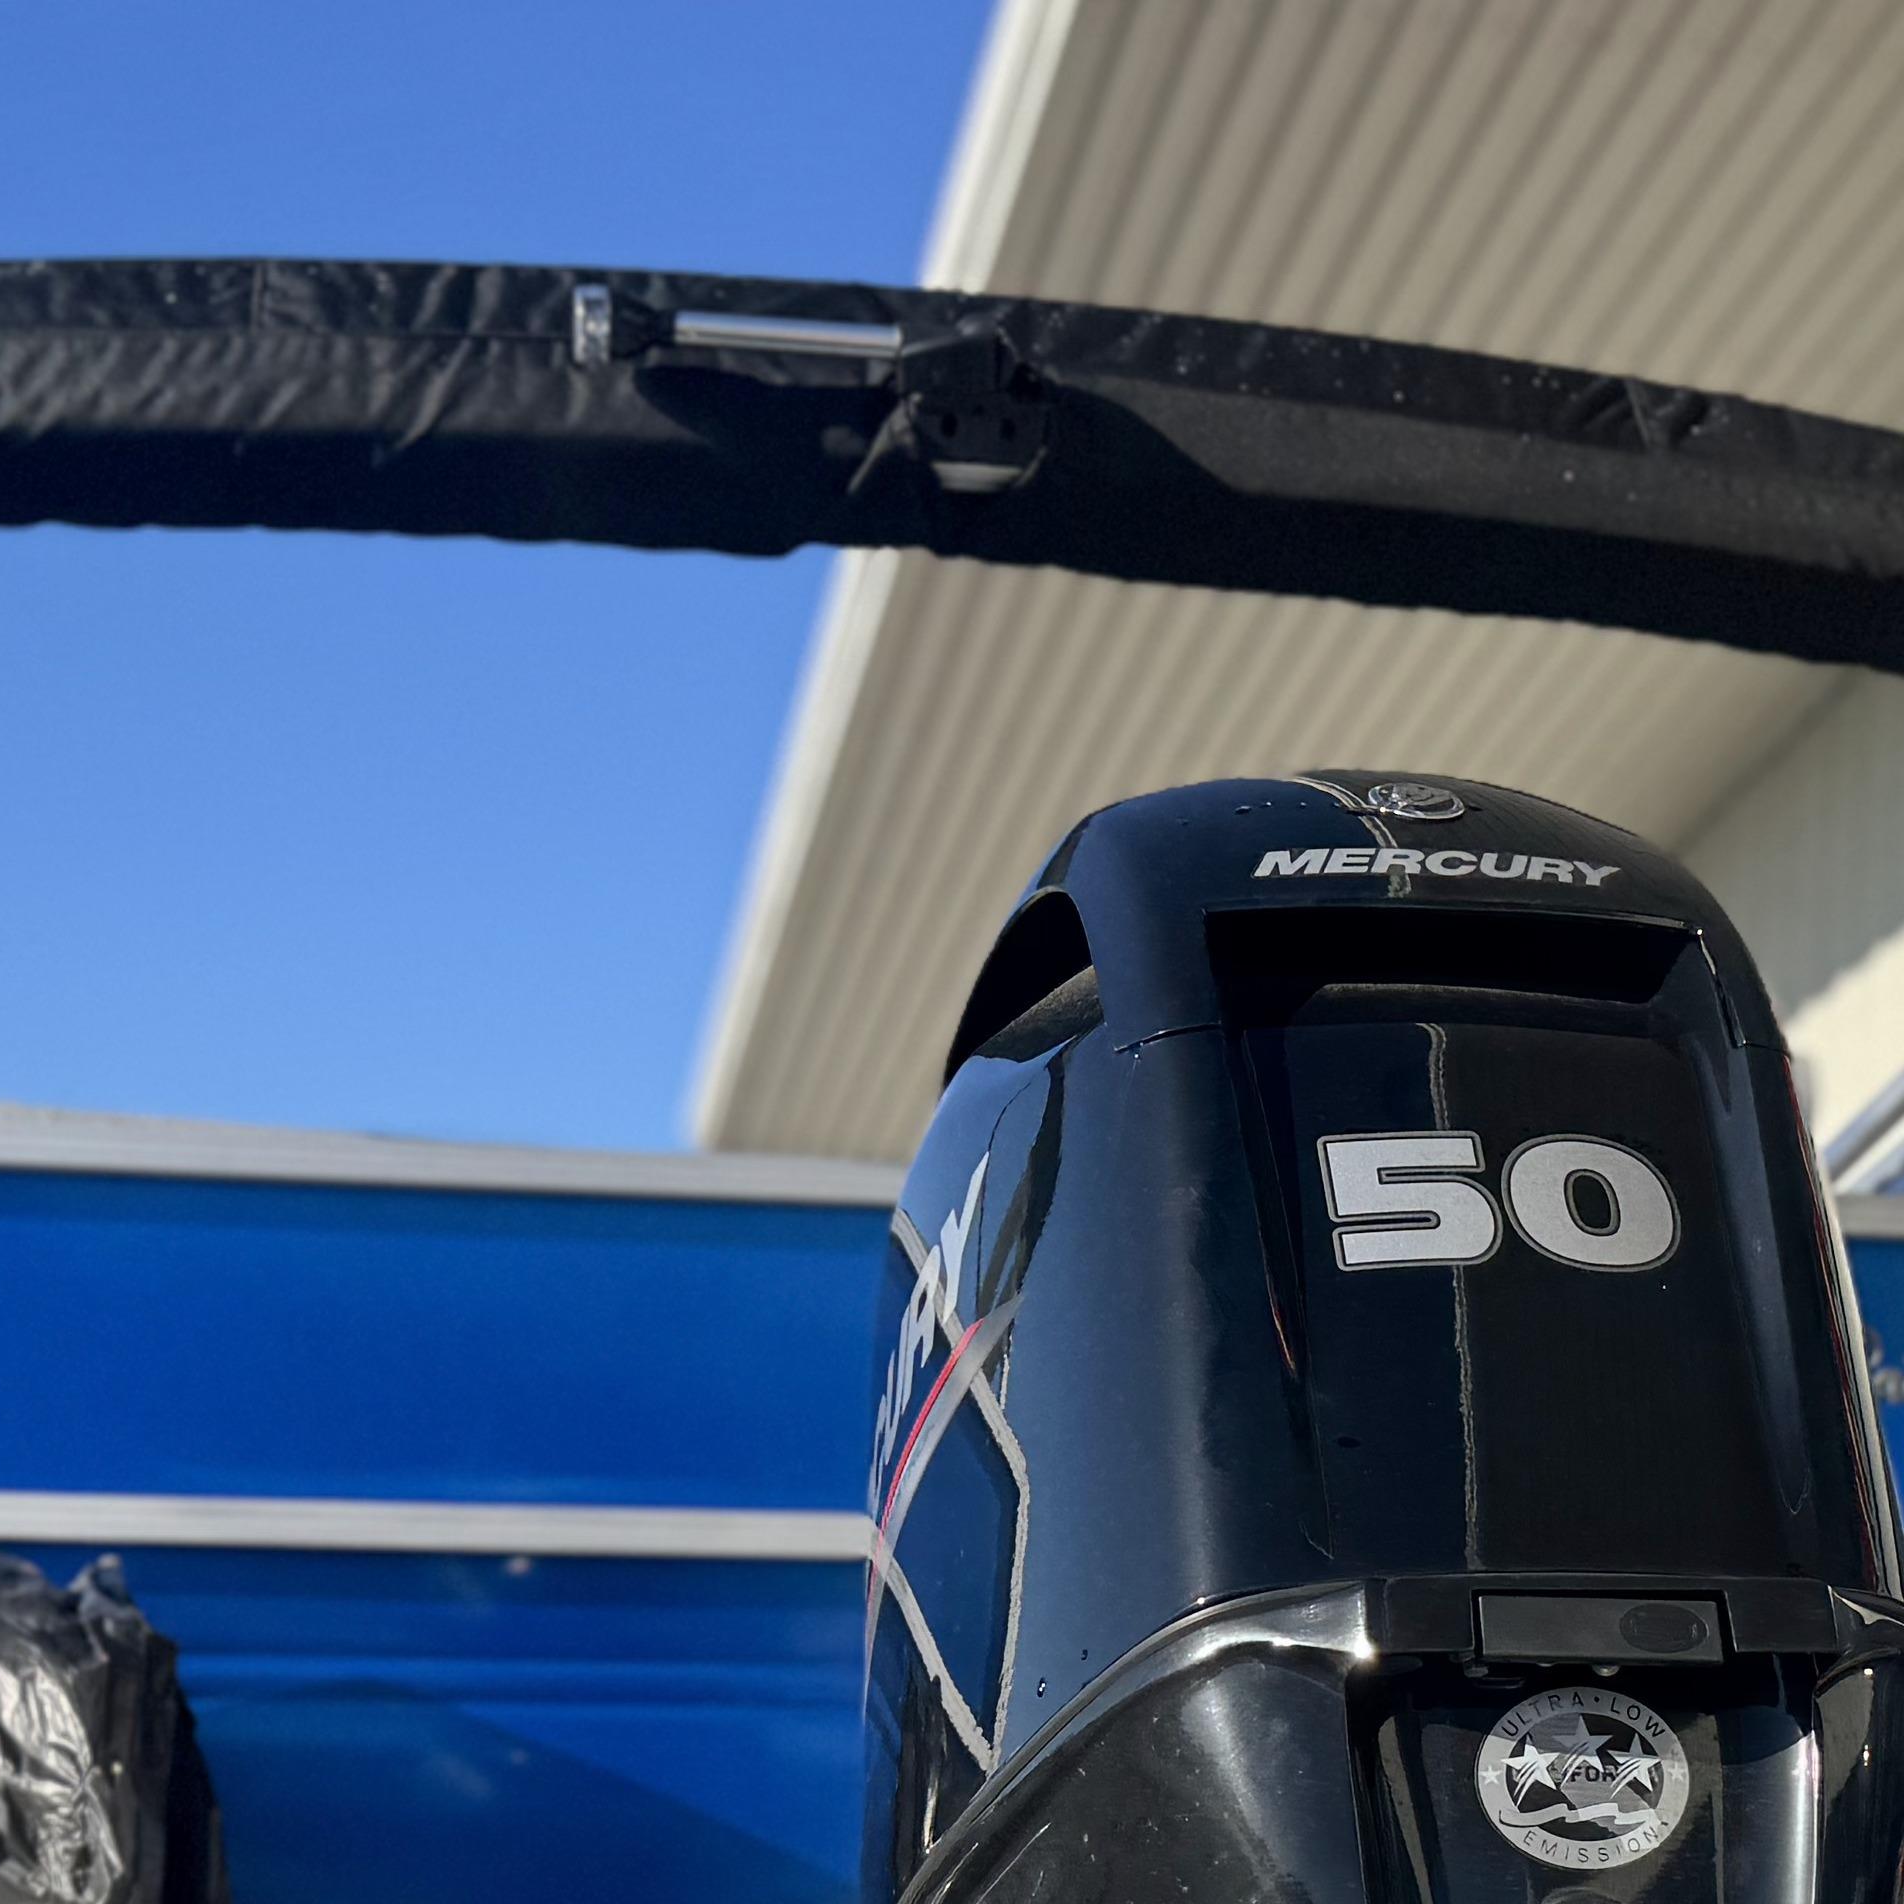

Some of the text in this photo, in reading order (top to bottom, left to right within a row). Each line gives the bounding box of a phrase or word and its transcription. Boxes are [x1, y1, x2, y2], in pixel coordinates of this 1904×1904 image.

[1253, 848, 1621, 887] MERCURY
[1316, 1129, 1681, 1271] 50
[1501, 1691, 1666, 1738] ULTRA LOW
[1522, 1827, 1660, 1864] EMISSION
